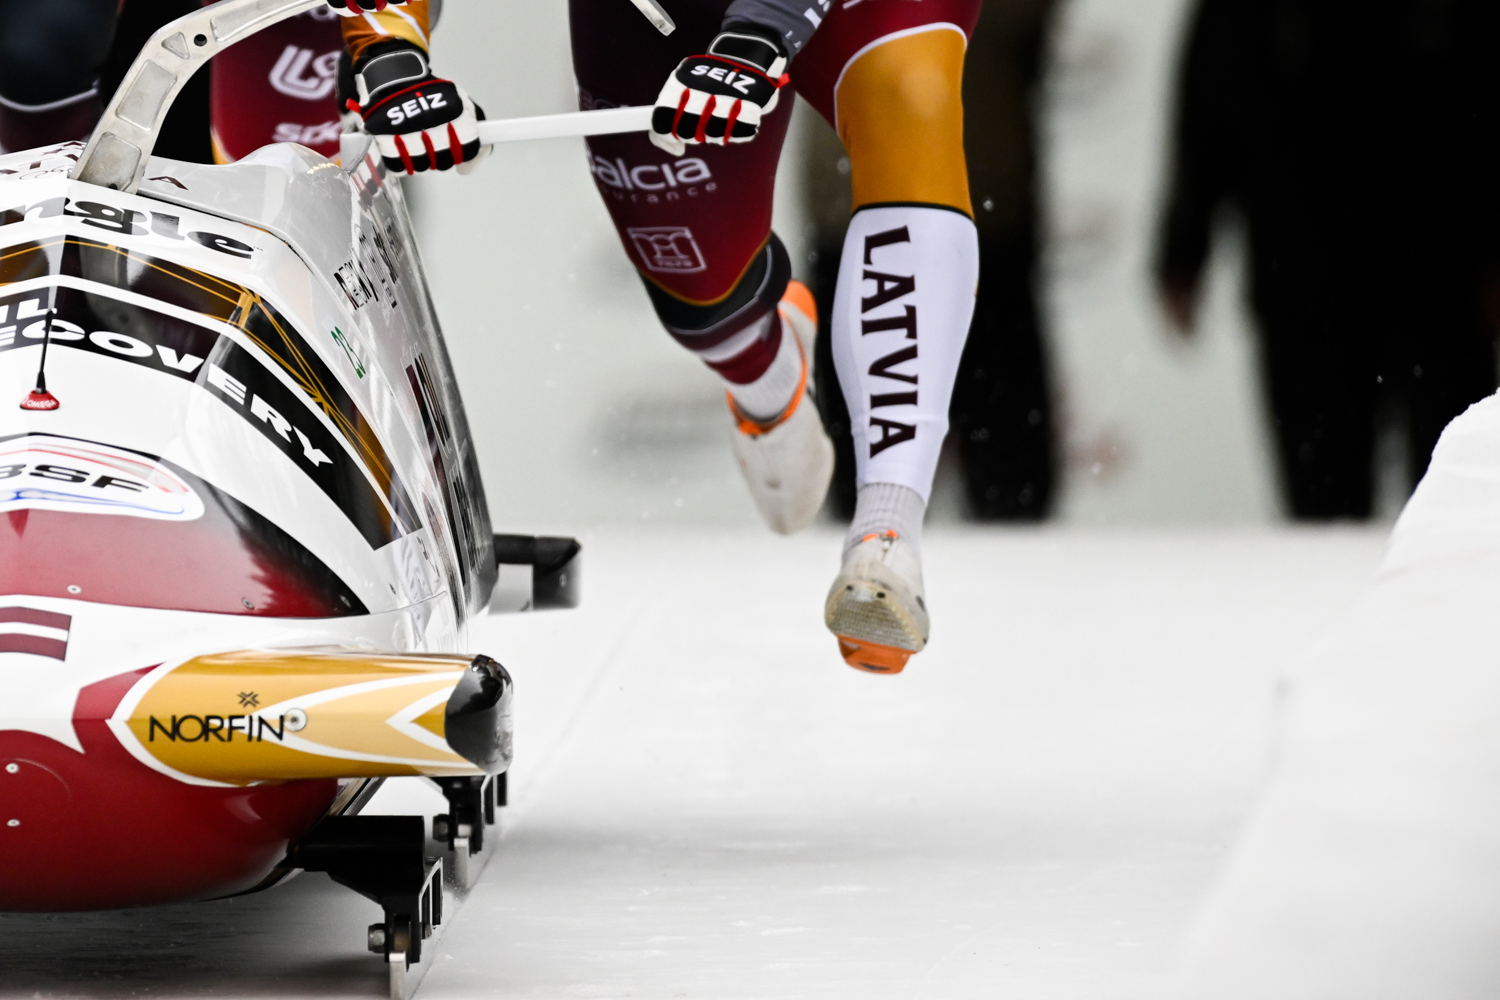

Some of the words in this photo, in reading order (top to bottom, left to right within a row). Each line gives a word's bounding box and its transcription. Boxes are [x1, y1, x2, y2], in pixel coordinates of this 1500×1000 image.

[690, 64, 756, 95] SEIZ
[386, 91, 448, 125] SEIZ
[861, 224, 919, 460] LATVIA
[149, 714, 285, 743] NORFIN
